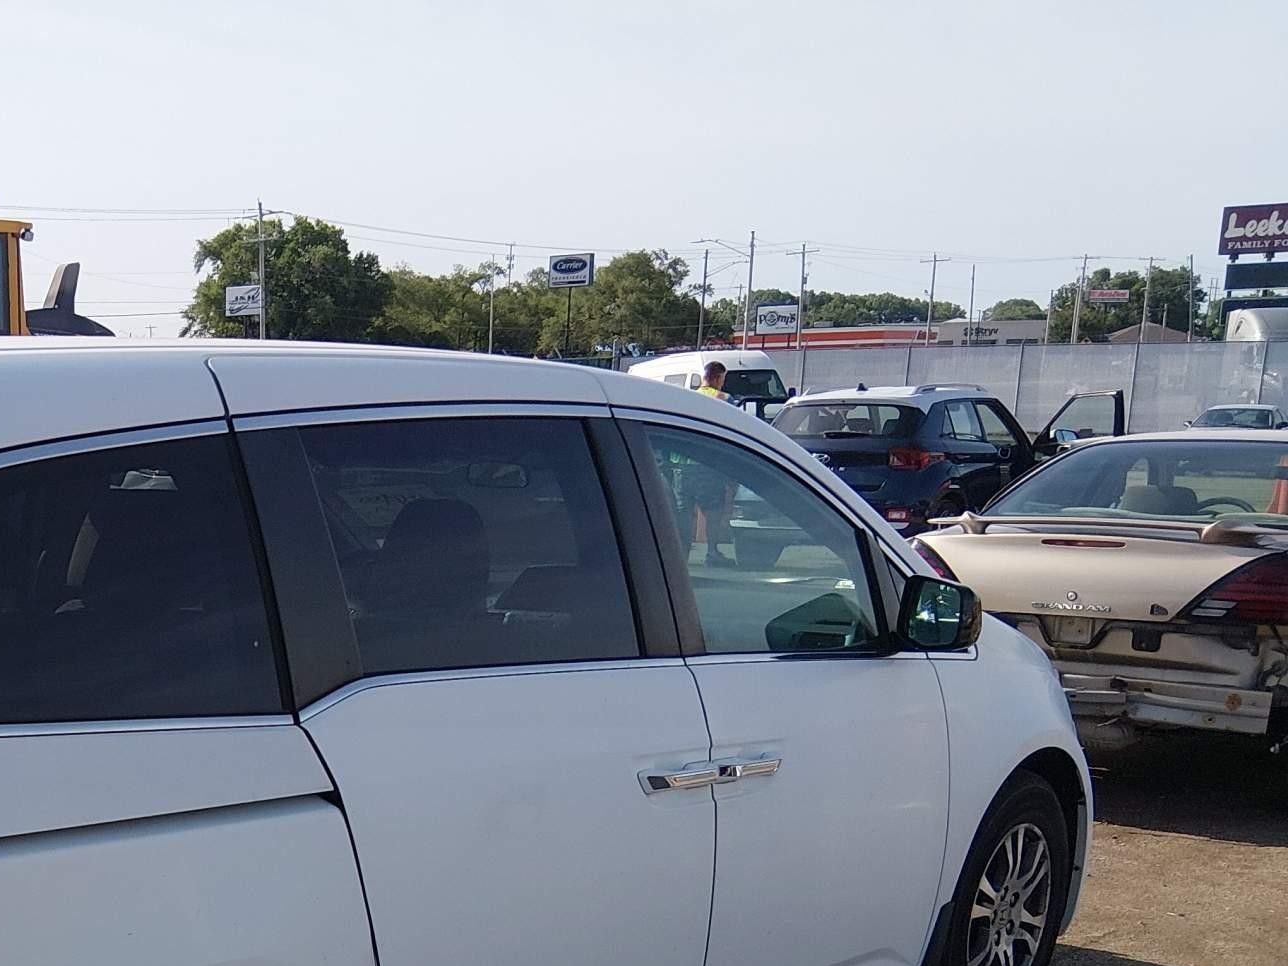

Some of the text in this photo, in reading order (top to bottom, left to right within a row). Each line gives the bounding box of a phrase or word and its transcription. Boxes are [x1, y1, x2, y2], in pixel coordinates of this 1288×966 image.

[1227, 239, 1272, 250] FAMILY
[556, 260, 583, 270] Carrier
[1086, 604, 1112, 613] AM
